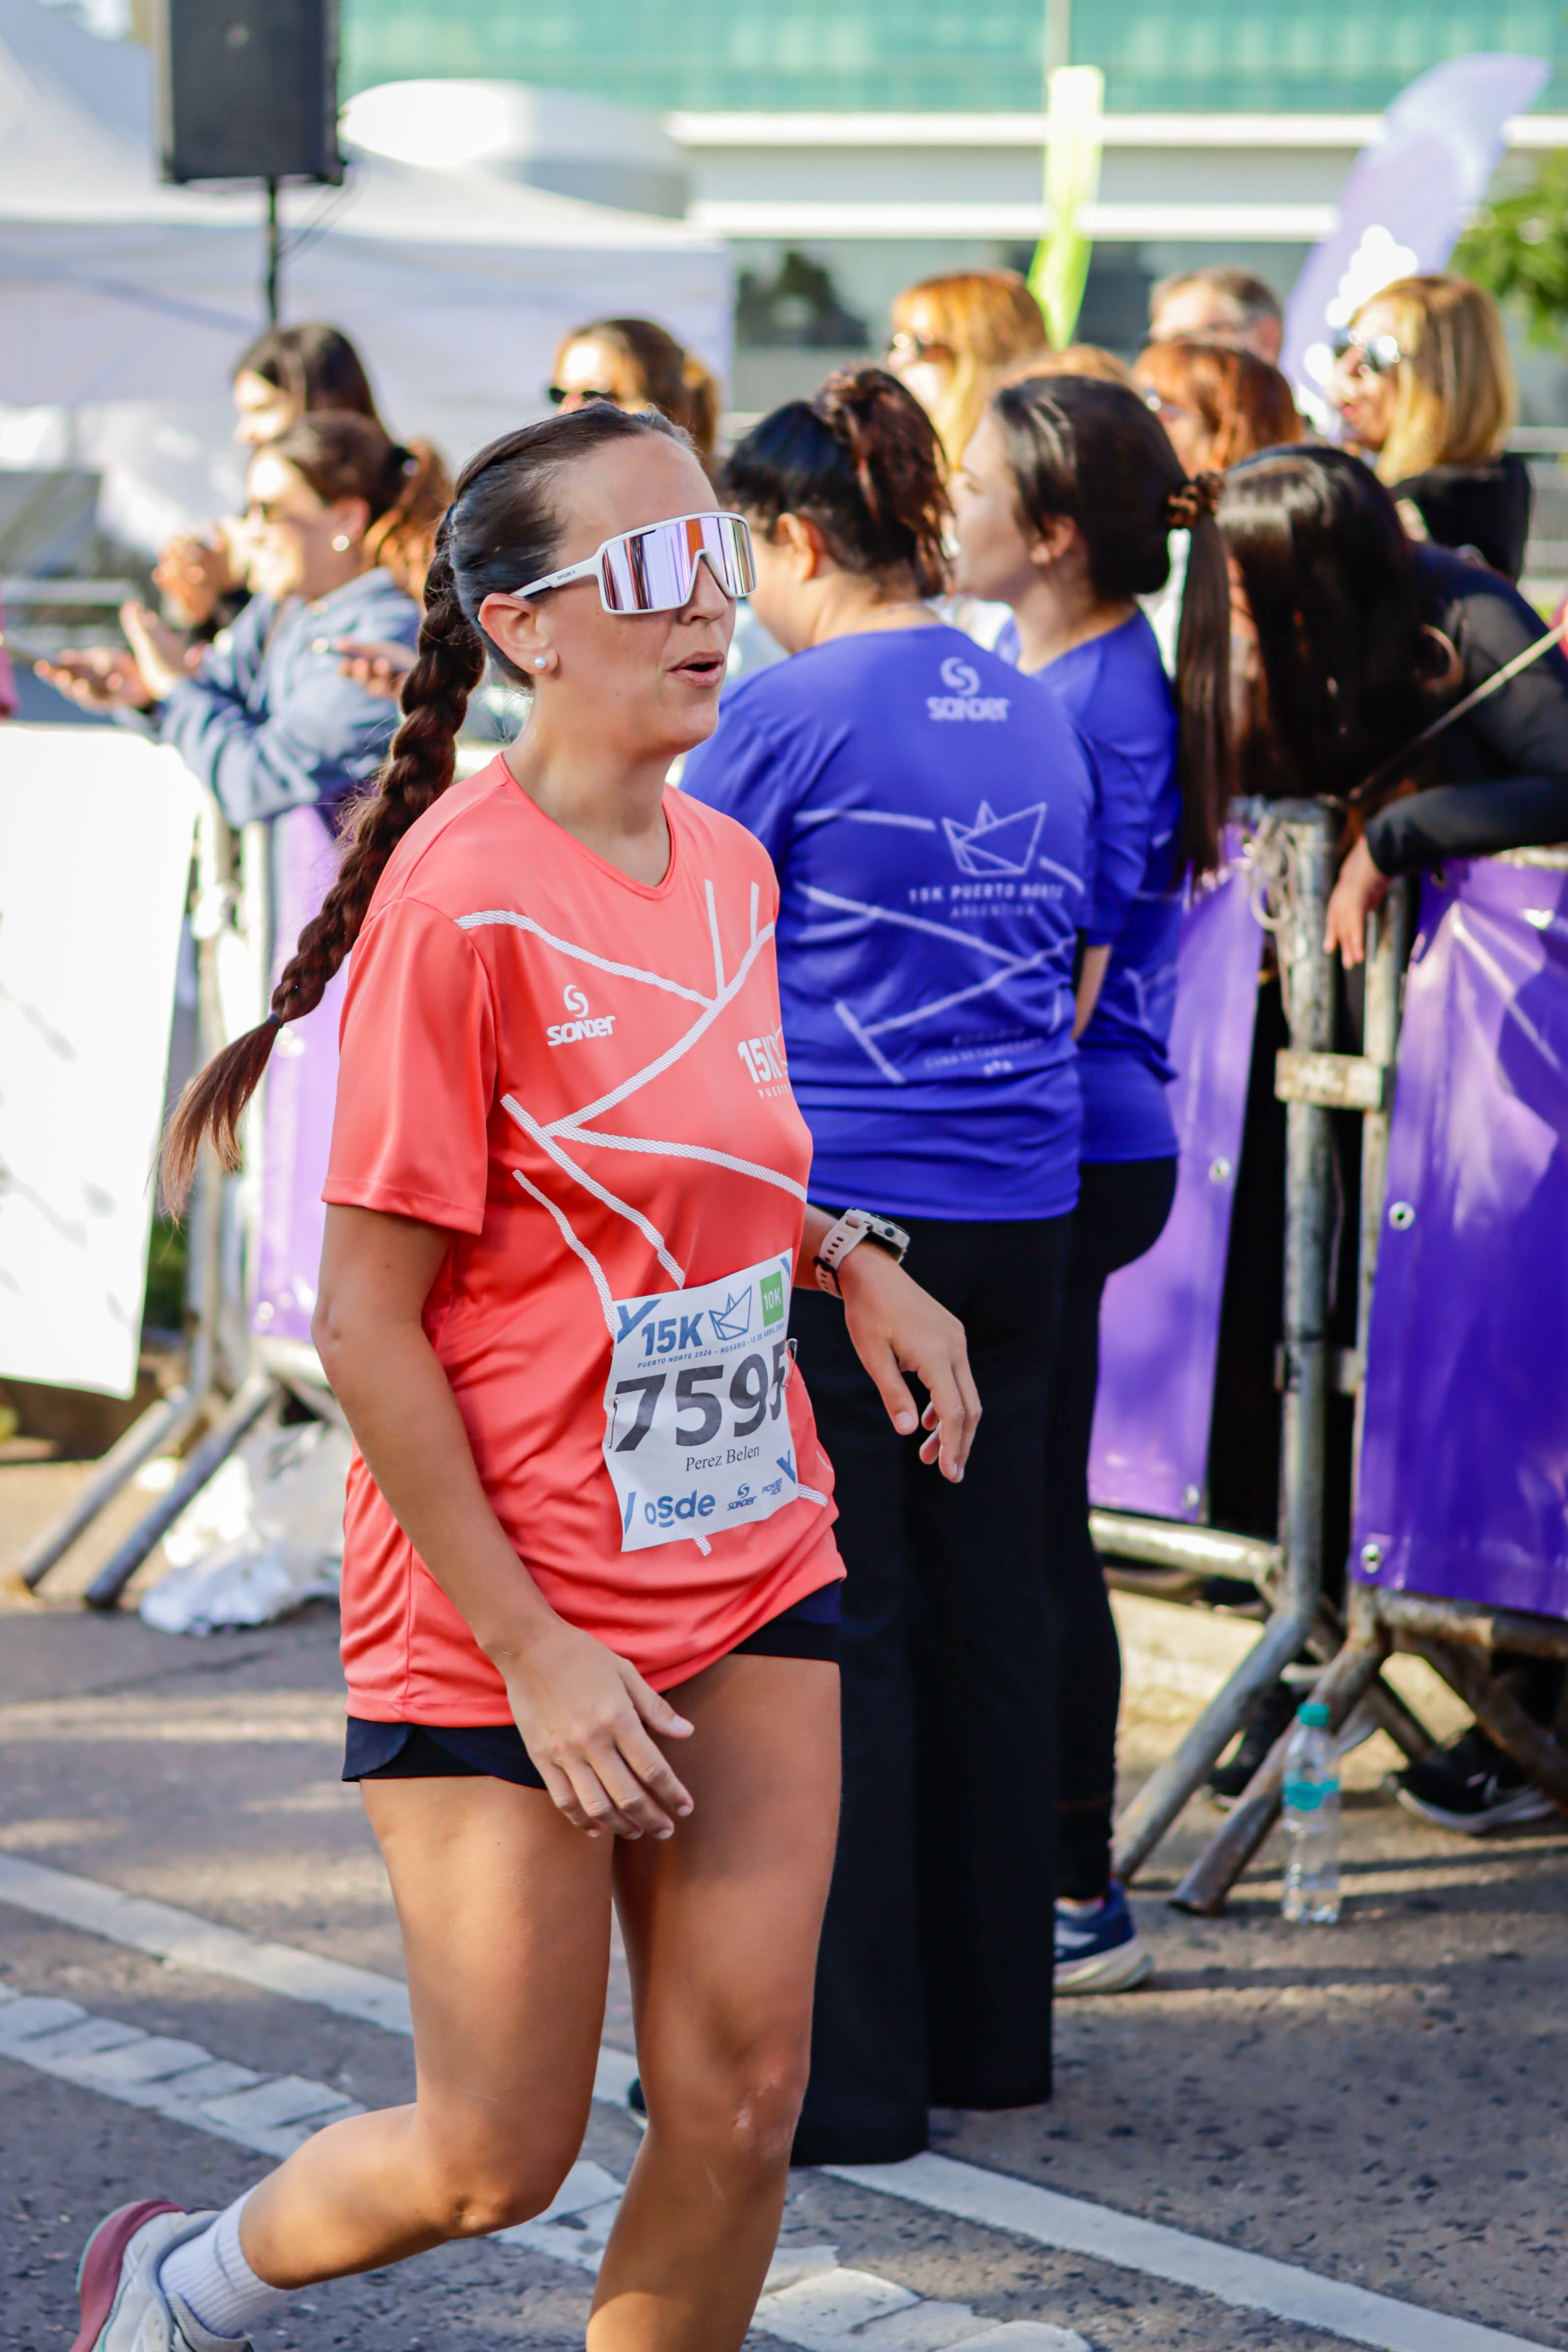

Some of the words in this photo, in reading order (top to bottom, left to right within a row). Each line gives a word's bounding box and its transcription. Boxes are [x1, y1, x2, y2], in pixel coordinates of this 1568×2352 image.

[764, 1287, 782, 1311] 10K
[642, 1312, 704, 1356] 15K
[637, 1358, 666, 1368] PUERTO
[668, 1353, 692, 1363] NORTE
[695, 1350, 712, 1358] 2026
[720, 1341, 745, 1353] ROSARIO
[615, 1340, 786, 1452] 7595
[685, 1455, 722, 1471] Perez
[726, 1445, 759, 1464] Belen
[645, 1489, 715, 1525] osde
